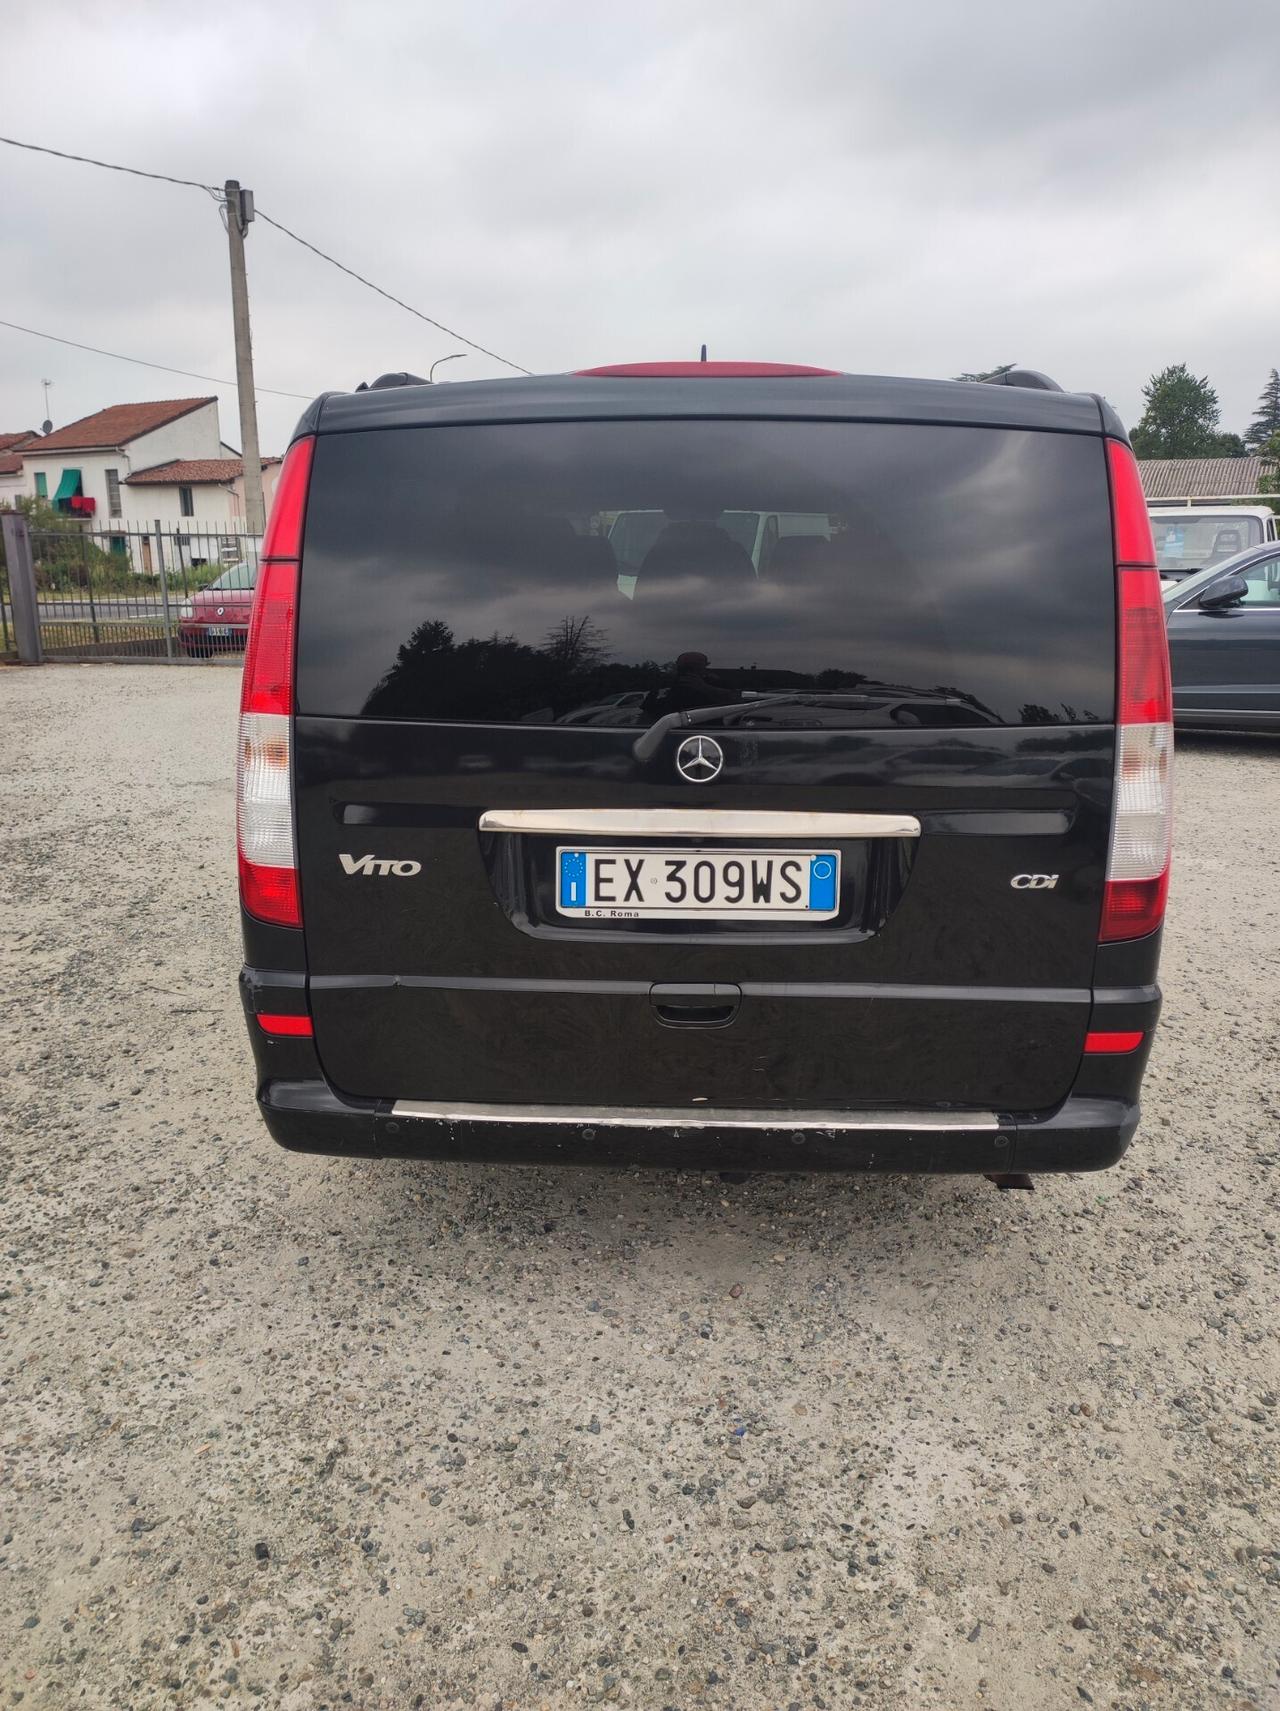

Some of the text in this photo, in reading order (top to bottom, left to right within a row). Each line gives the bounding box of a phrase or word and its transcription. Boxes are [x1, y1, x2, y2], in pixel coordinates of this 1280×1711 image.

[570, 881, 577, 901] I
[594, 859, 802, 904] EX 309WS
[610, 910, 640, 918] Roma
